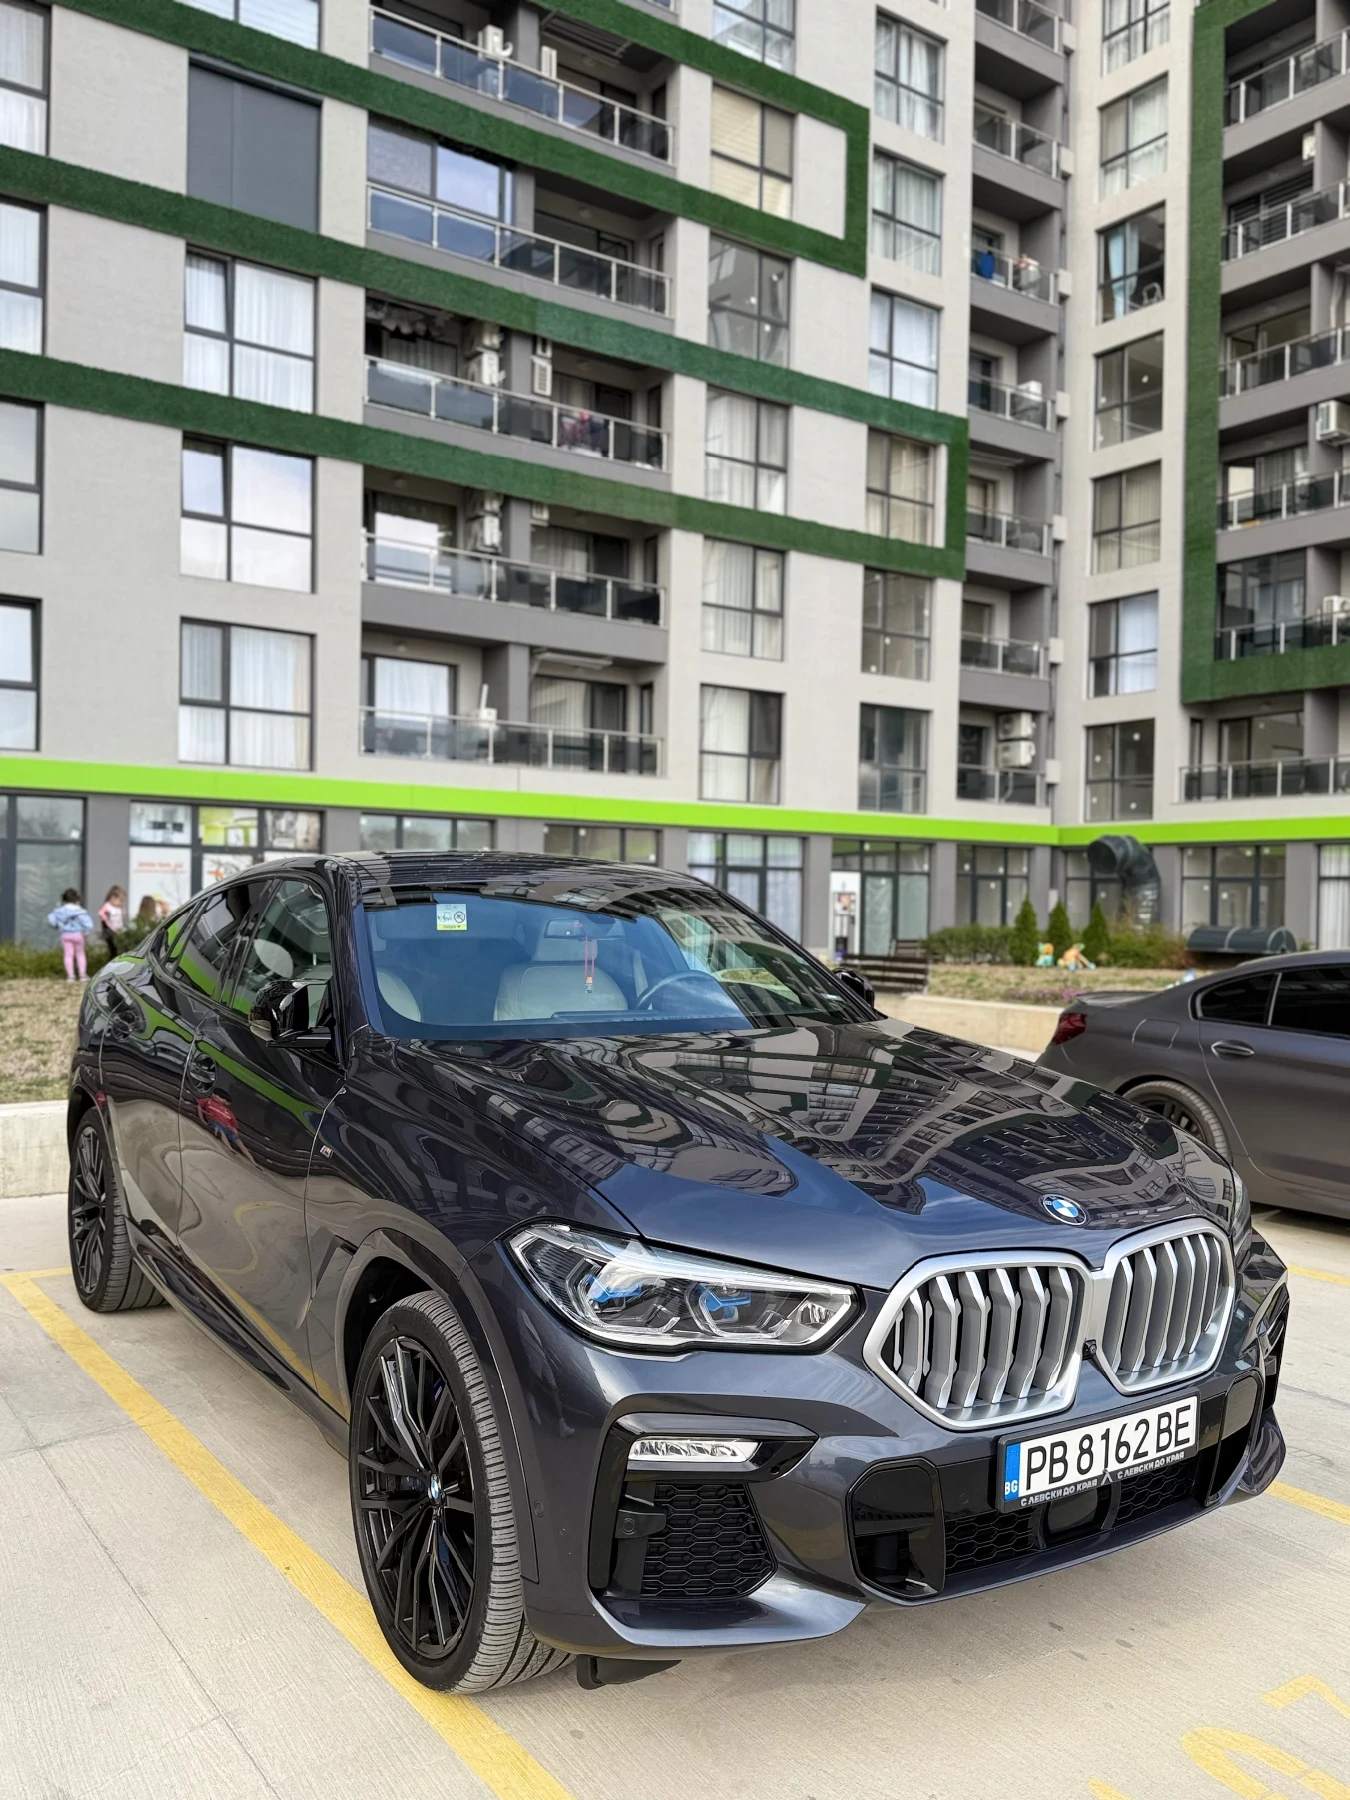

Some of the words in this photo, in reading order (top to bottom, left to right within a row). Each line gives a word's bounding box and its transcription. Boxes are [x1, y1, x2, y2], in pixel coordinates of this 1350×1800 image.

[1025, 1440, 1068, 1491] PB
[1076, 1418, 1150, 1476] 8162
[1155, 1404, 1191, 1453] BE
[1004, 1479, 1018, 1496] BG
[1028, 1488, 1062, 1505] ЛЕВСКИ
[1062, 1485, 1076, 1496] ДО
[1076, 1478, 1098, 1492] КРАЯ
[1124, 1461, 1154, 1478] ЛЕВСКИ
[1154, 1457, 1165, 1469] ДО
[1165, 1451, 1185, 1464] КРАЯ
